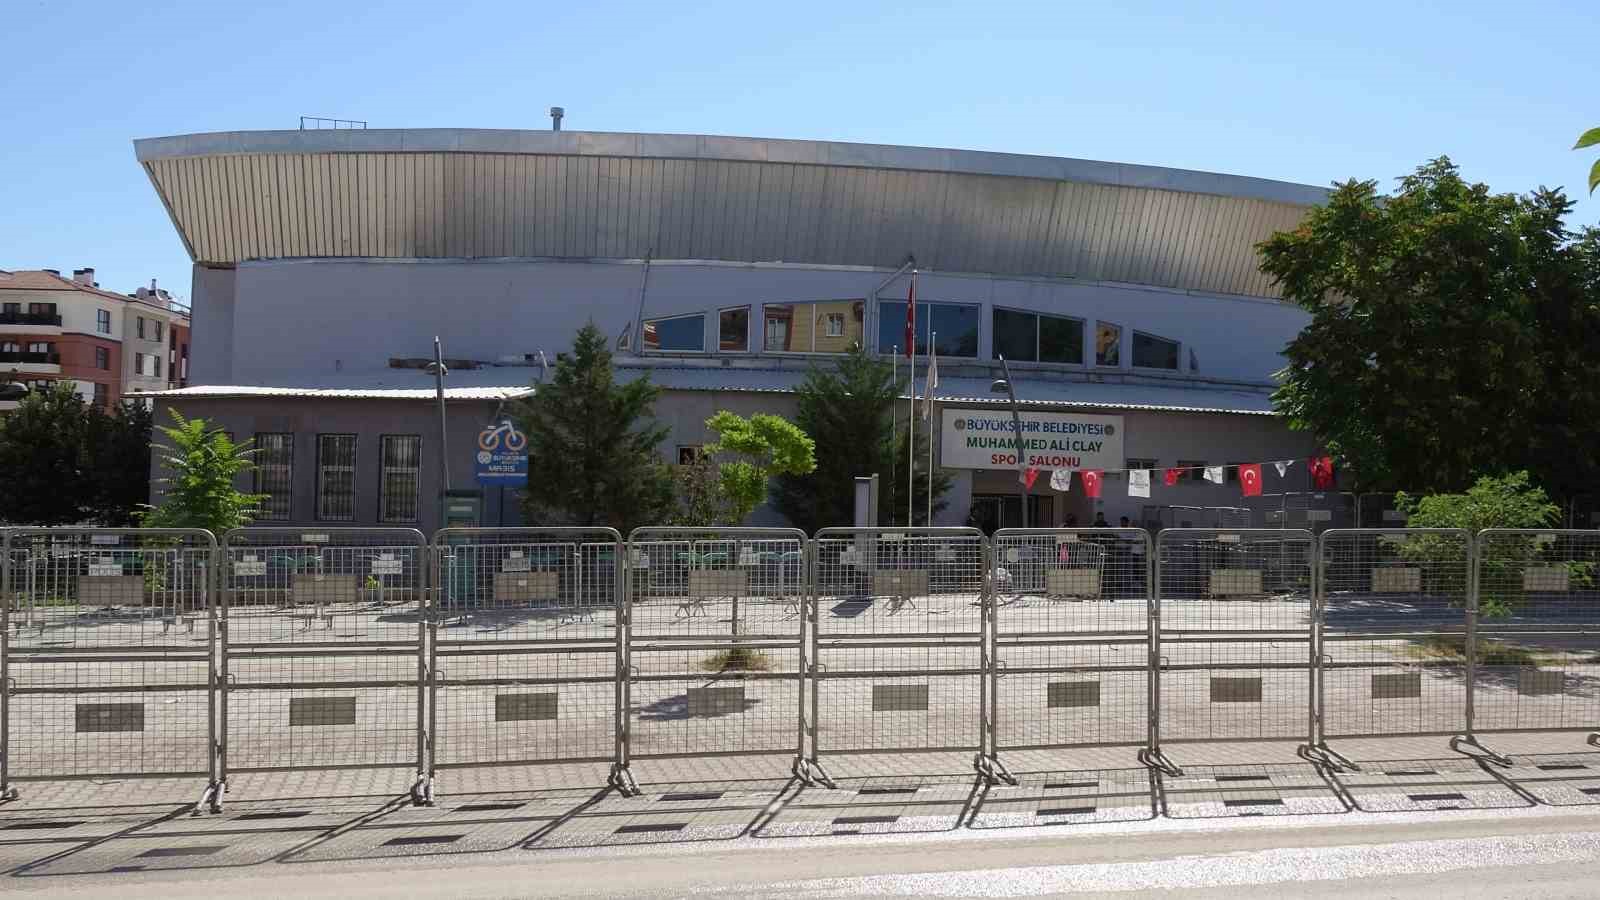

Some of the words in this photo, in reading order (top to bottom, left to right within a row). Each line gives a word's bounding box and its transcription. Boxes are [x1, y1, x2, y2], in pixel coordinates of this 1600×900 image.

[966, 417, 1041, 433] BÜYÜKŞHİR
[966, 436, 1047, 450] MUHAMMED
[1049, 436, 1070, 451] ALİ
[1072, 440, 1103, 453] CLAY
[991, 454, 1024, 465] SPO
[1029, 455, 1081, 468] SALONU
